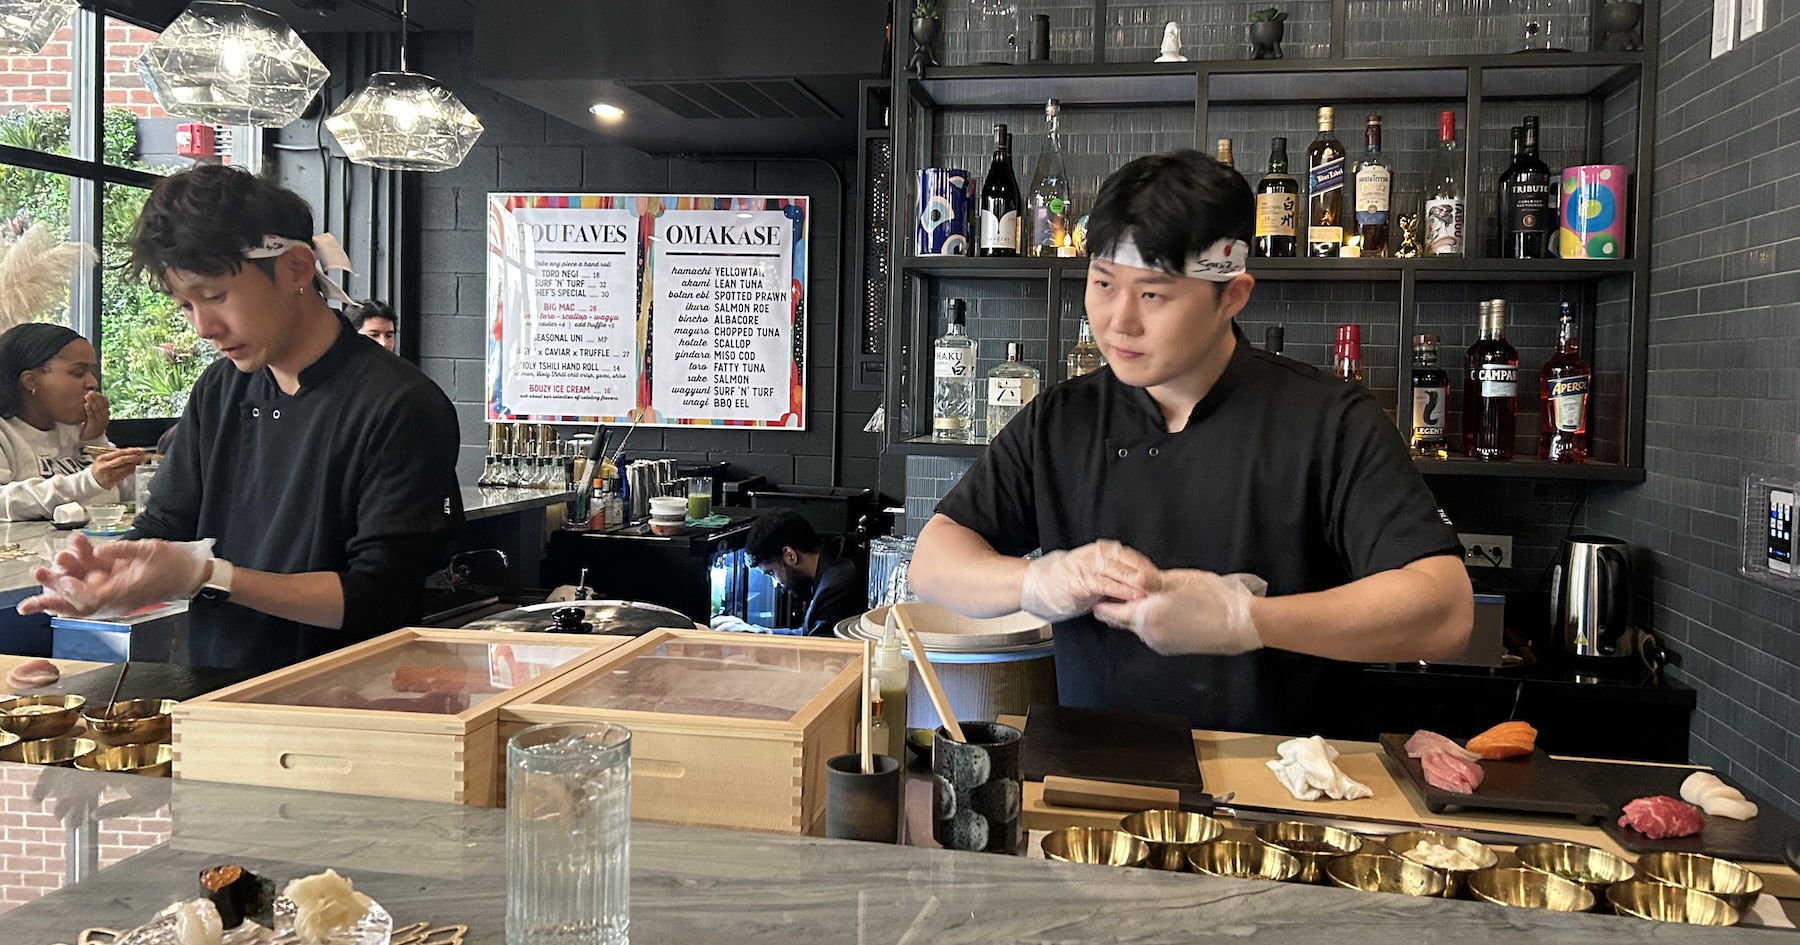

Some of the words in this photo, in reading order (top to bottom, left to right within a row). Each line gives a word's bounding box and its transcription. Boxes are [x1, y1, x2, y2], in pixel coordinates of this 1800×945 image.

[1512, 185, 1548, 193] TRIBUTE
[666, 225, 781, 245] OMAKASE
[671, 267, 711, 275] hamachi
[682, 279, 710, 287] akami
[715, 279, 736, 288] LEAN
[740, 280, 763, 288] TUNA
[557, 289, 586, 297] SPECIAL
[715, 291, 752, 300] SPOTTED
[756, 292, 787, 301] PRAWN
[685, 303, 710, 311] ikura
[714, 303, 750, 312] SALMON
[753, 304, 770, 313] ROE
[562, 313, 587, 322] scallop
[594, 314, 619, 323] wagyu
[714, 315, 759, 324] ALBACORE
[674, 328, 710, 337] maguro
[714, 327, 753, 336] CHOPPED
[757, 328, 780, 337] TUNA
[679, 338, 708, 346] hotate
[714, 339, 751, 348] SCALLOP
[545, 348, 570, 356] CAVIAR
[580, 348, 610, 357] TRUFFLE
[675, 350, 711, 360] gindara
[714, 351, 735, 360] MISO
[738, 351, 756, 360] COD
[539, 362, 560, 370] TSHILI
[714, 363, 739, 372] FATTY
[743, 364, 765, 372] TUNA
[714, 375, 749, 384] SALMON
[529, 384, 551, 392] BOUZY
[553, 385, 564, 393] ICE
[566, 385, 590, 393] CREAM
[672, 386, 711, 396] wagyuni
[714, 387, 735, 395] SURF
[752, 387, 774, 396] TURF
[683, 398, 709, 408] unagi
[714, 399, 732, 408] BBQ
[735, 399, 749, 408] EEL
